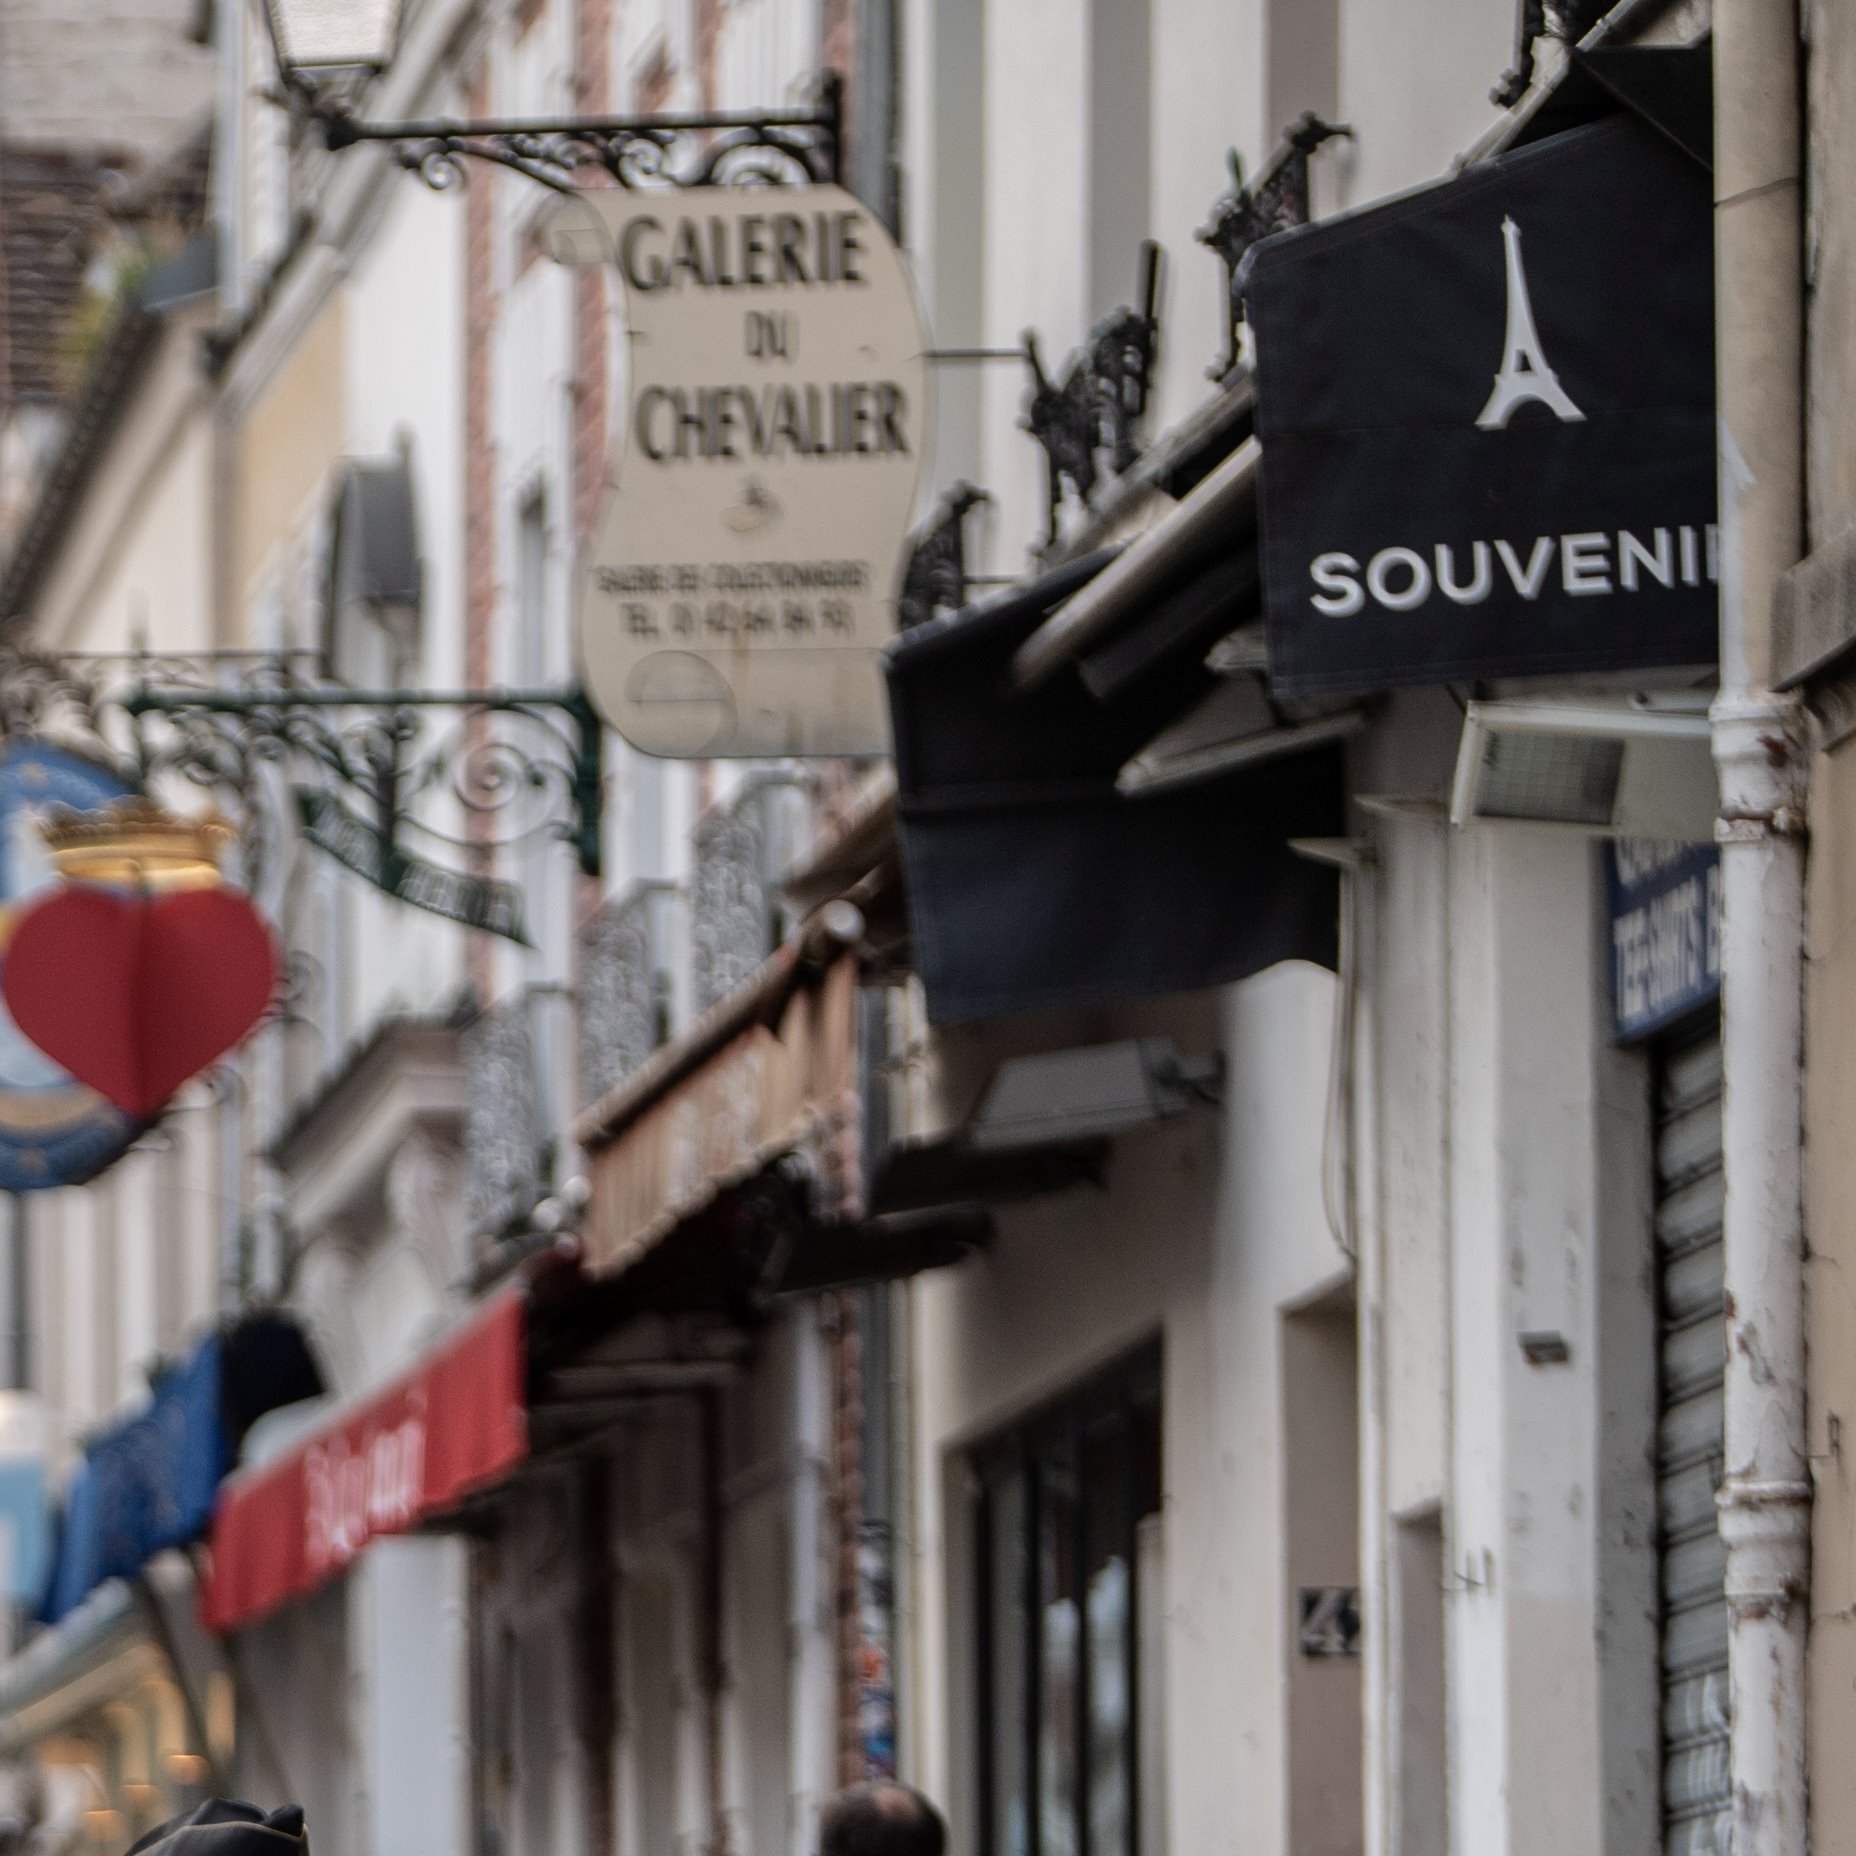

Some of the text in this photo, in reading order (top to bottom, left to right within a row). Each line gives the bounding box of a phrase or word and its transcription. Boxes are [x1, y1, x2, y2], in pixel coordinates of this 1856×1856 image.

[620, 209, 868, 292] GALERIE
[744, 309, 799, 363] DU
[635, 380, 912, 464] CHEVALIER
